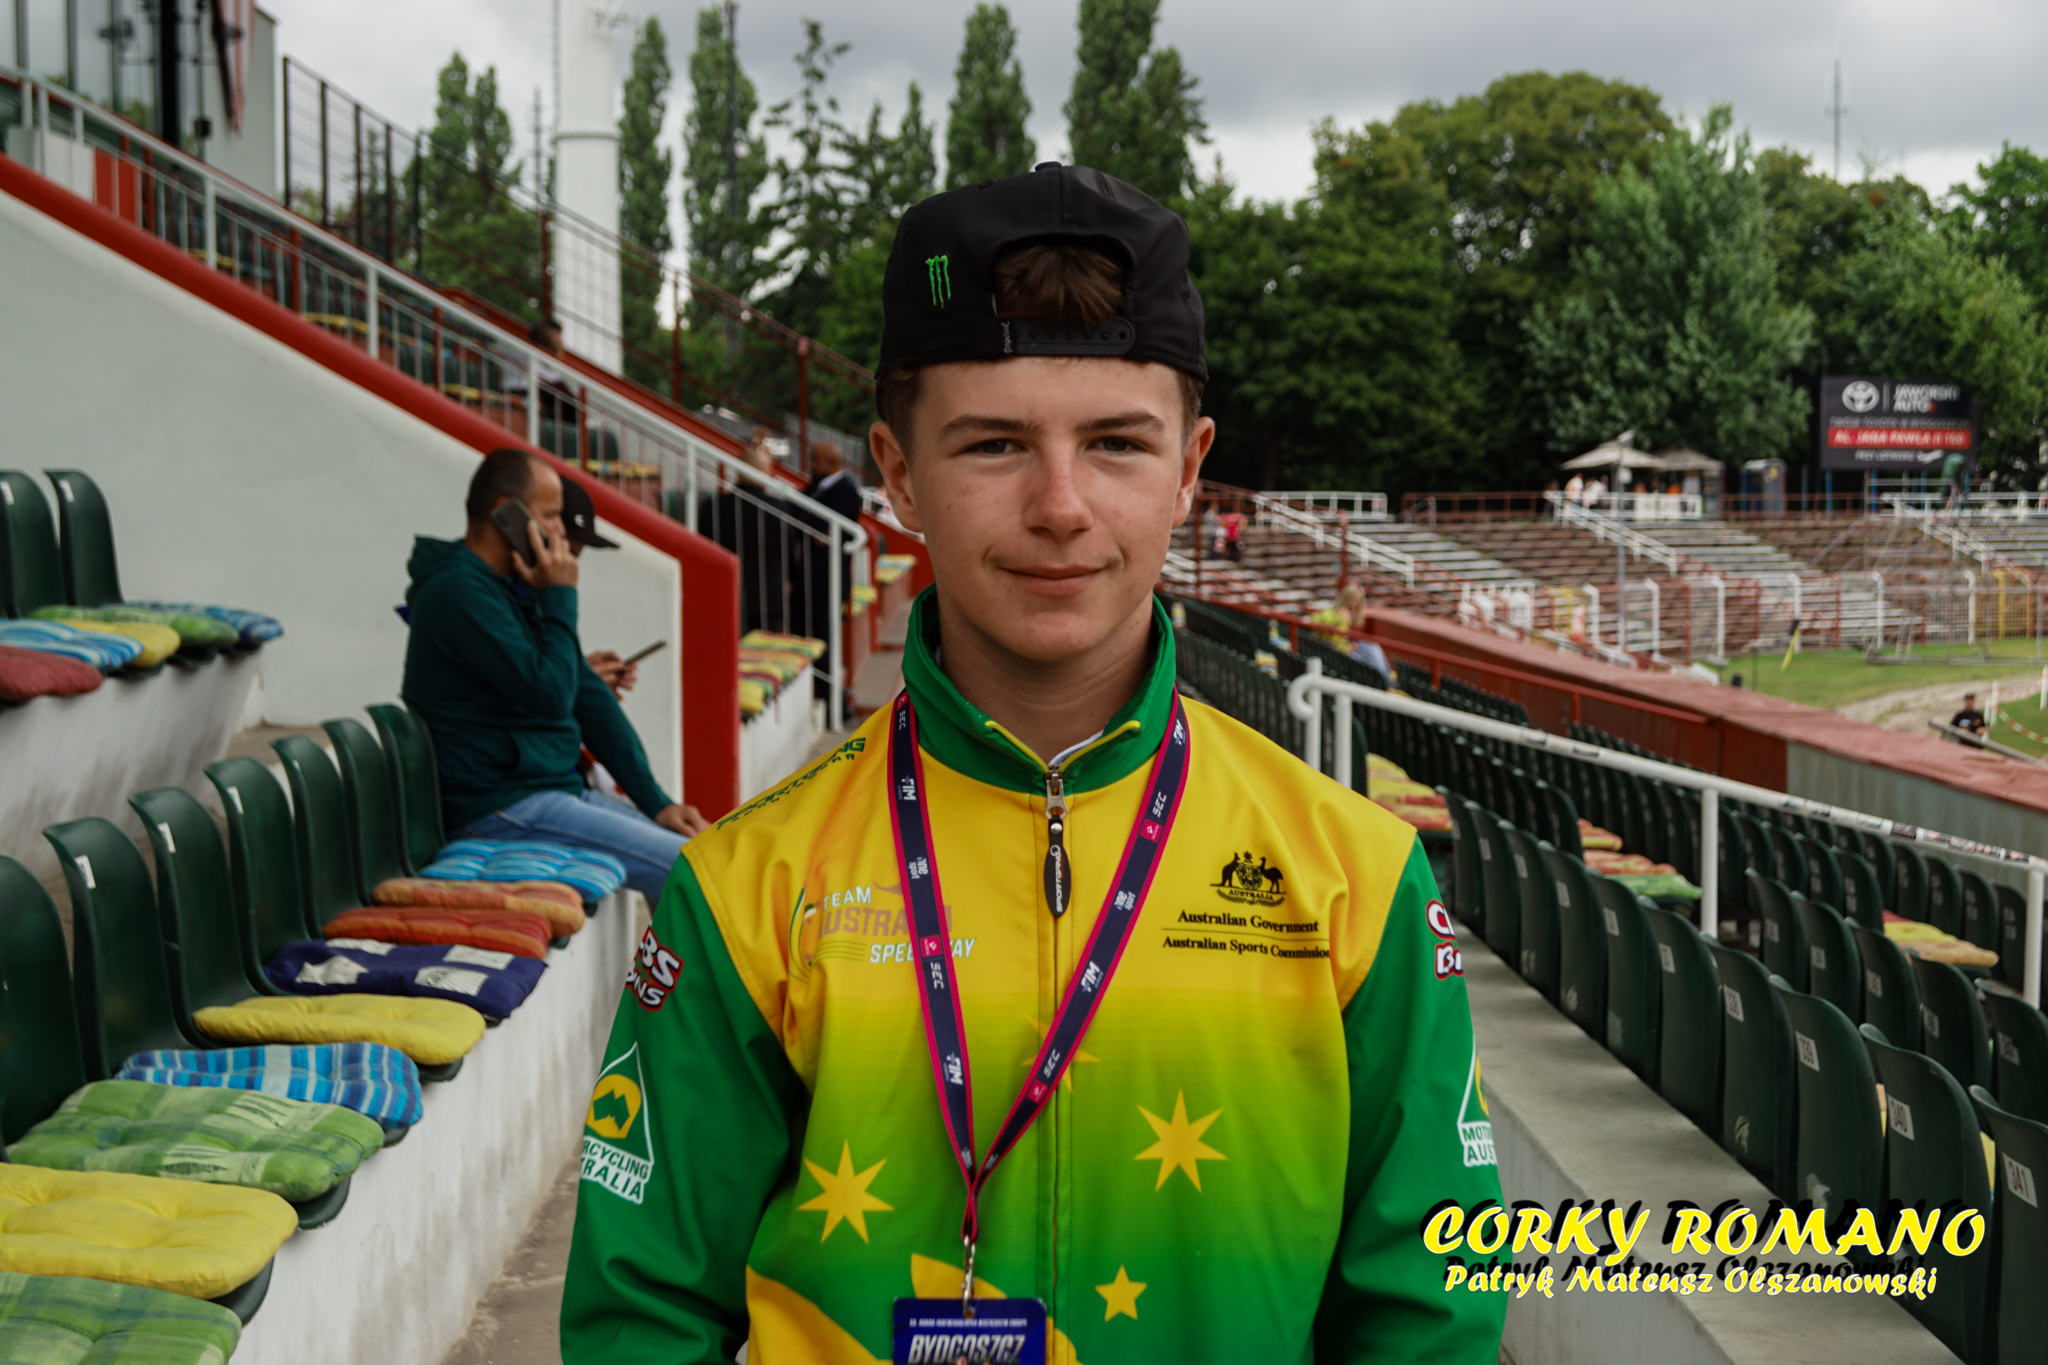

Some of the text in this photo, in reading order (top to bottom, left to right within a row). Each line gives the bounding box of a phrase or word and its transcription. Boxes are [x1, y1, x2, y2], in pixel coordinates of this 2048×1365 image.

[1893, 399, 1927, 413] AUTO
[901, 777, 917, 800] FIM
[1152, 791, 1167, 818] SEC
[823, 885, 872, 912] TEAM
[1228, 889, 1274, 902] AUSTRALIA
[1177, 910, 1319, 933] Australian Government
[638, 928, 680, 988] BS
[869, 938, 976, 964] SPEEAY
[1162, 936, 1227, 951] Australian
[1230, 940, 1268, 956] Sports
[930, 962, 945, 990] SEC
[1081, 960, 1100, 993] FIM
[946, 1055, 963, 1085] FIM
[1043, 1048, 1060, 1079] SEC
[1889, 1098, 1909, 1135] 340
[581, 1157, 642, 1200] RALIA
[2008, 1159, 2029, 1200] 341
[907, 1334, 1026, 1365] BYDGOSZCZ
